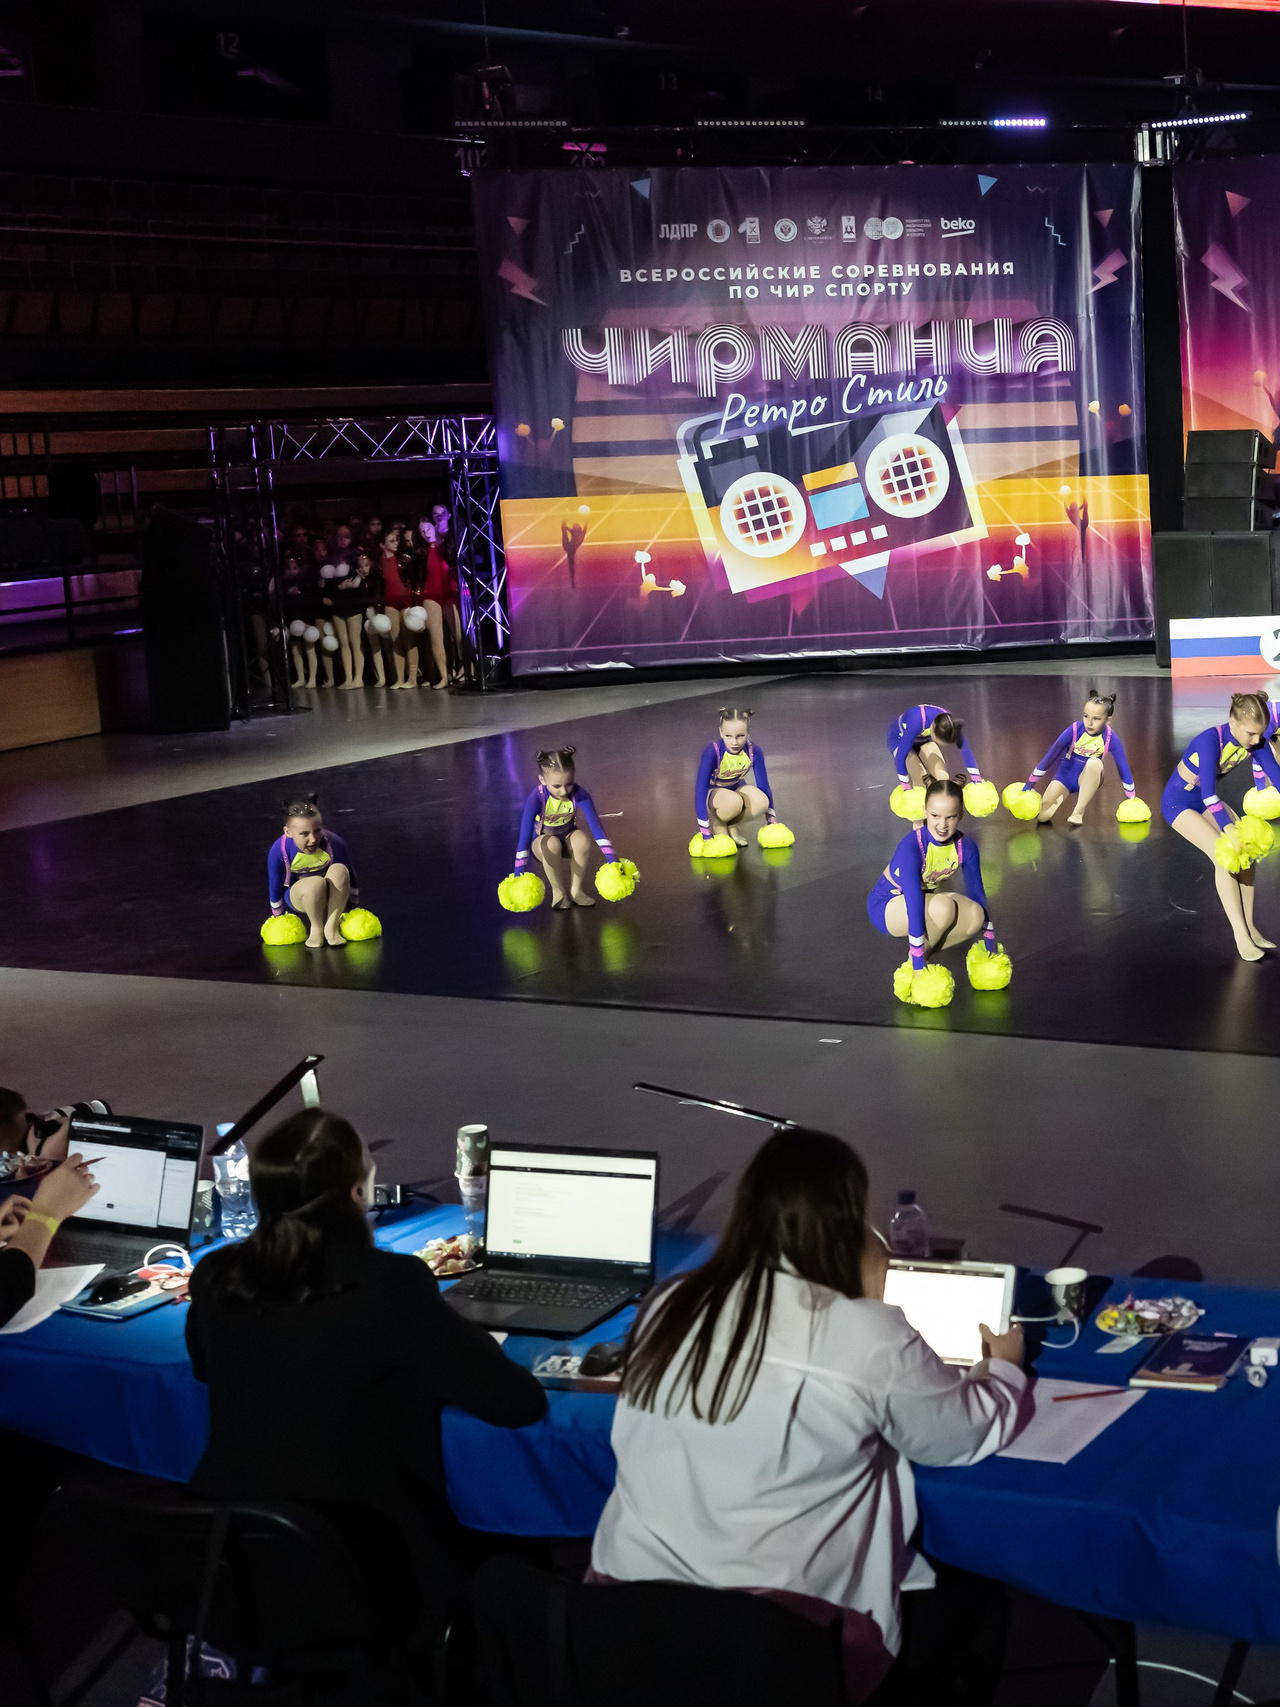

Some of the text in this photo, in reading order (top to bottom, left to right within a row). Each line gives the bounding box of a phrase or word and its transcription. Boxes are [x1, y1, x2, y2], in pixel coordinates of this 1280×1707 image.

[659, 223, 698, 240] ЛДПР
[940, 217, 976, 230] beko
[619, 261, 1016, 283] ВСЕРОССИЙСКИЕ СОРЕВНОВАНИЯ
[728, 282, 914, 299] ПО ЧИР СПОРТУ
[719, 373, 949, 435] Ретро Стиль
